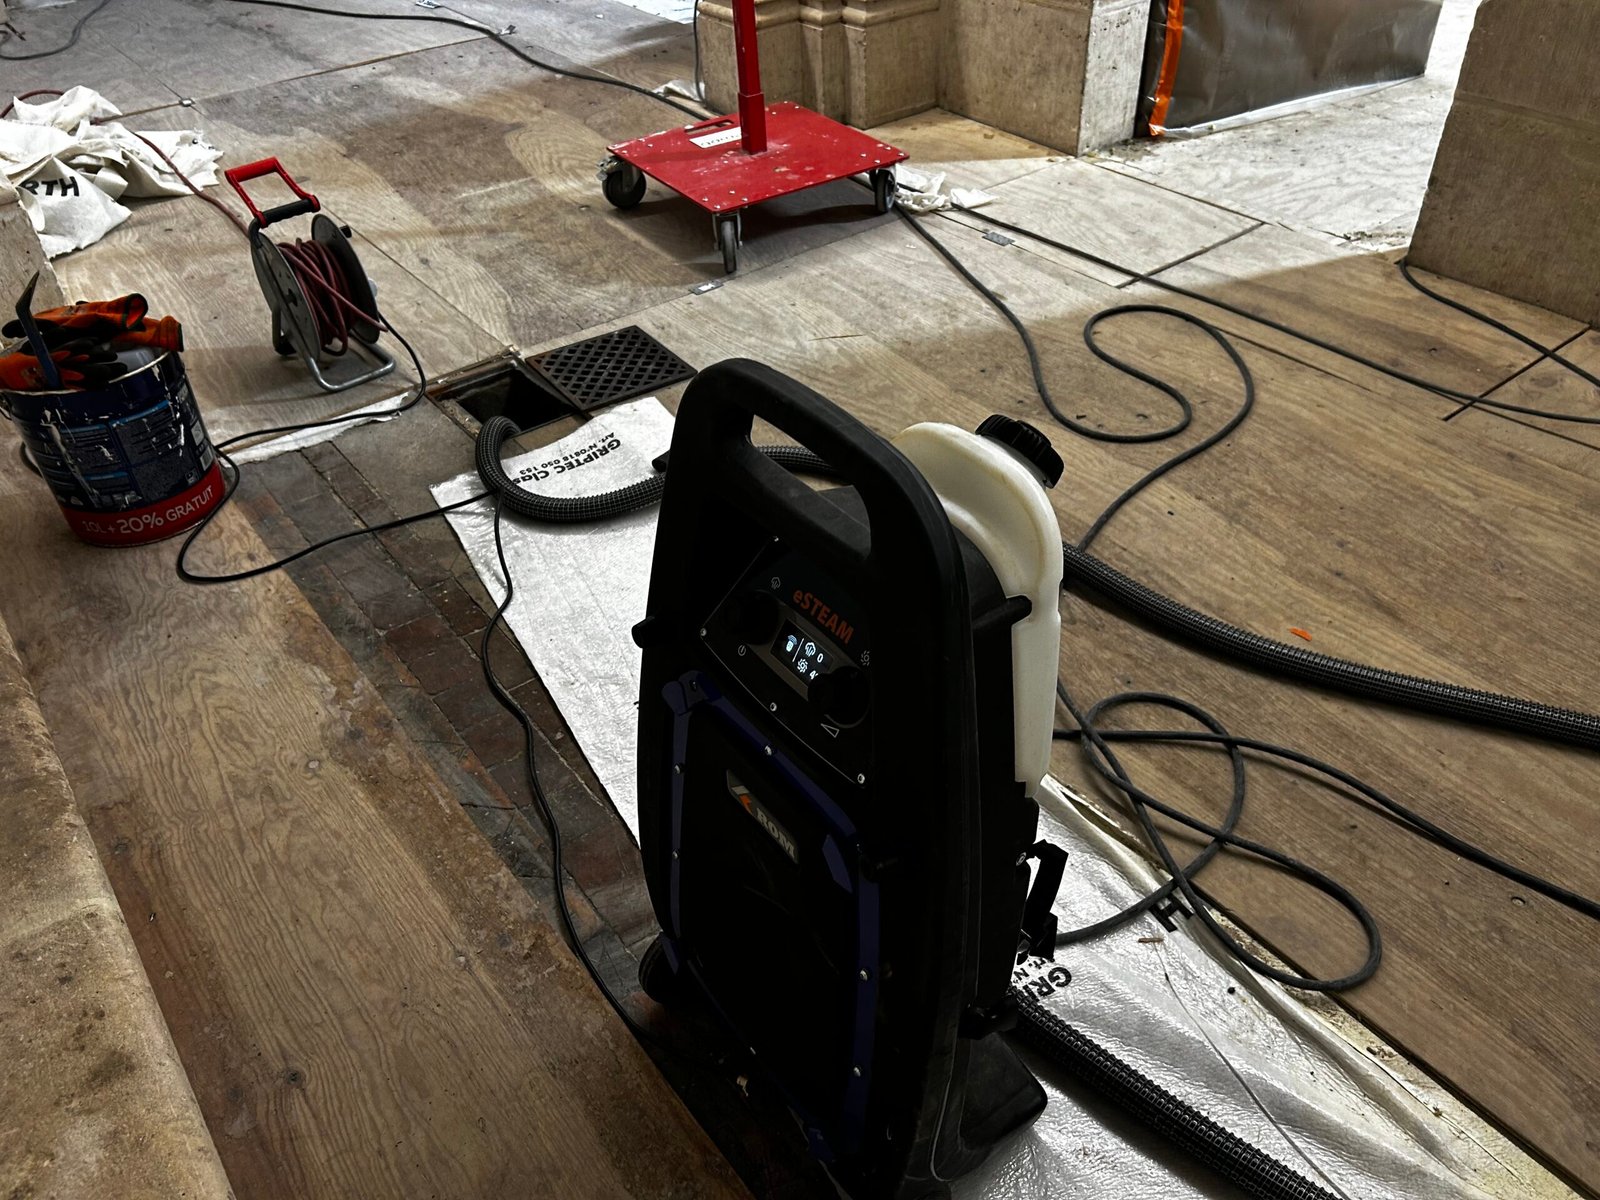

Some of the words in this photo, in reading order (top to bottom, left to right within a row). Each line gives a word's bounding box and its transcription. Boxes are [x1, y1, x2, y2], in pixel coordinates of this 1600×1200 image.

[553, 439, 621, 474] GRIPTEC
[599, 432, 615, 443] Art.
[117, 511, 164, 534] 20%
[166, 484, 214, 523] GRATUIT
[792, 589, 855, 645] eSTEAM
